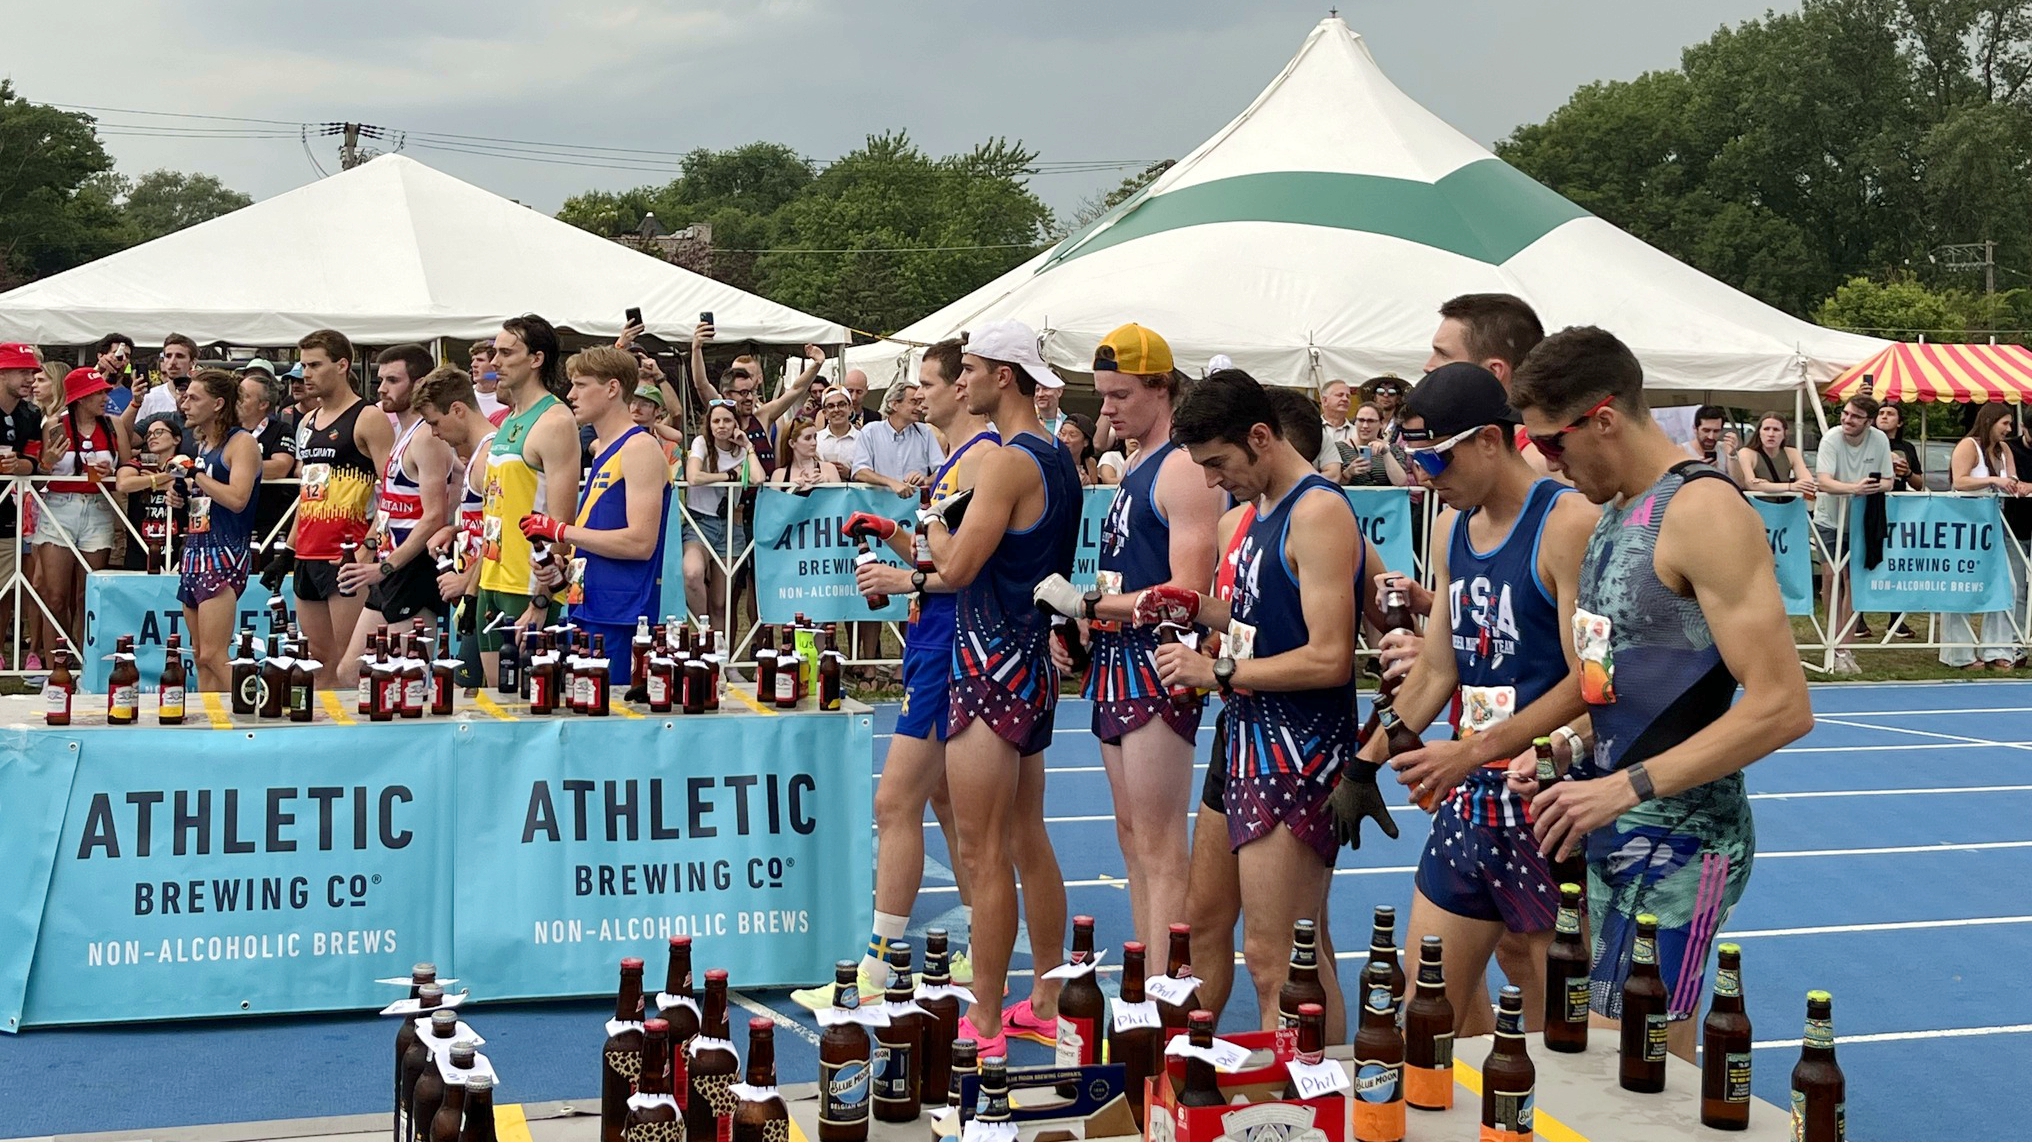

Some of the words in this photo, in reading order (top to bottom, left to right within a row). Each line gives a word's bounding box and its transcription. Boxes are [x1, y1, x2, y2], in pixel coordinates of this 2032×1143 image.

[300, 448, 336, 459] BELGIUM
[306, 484, 319, 498] 12
[1886, 522, 1992, 551] THLETIC
[1888, 558, 1950, 573] BREWING
[1871, 580, 1947, 592] NON-ALCOHOLIC
[1950, 581, 1984, 593] BREWS
[1449, 576, 1520, 641] USA
[1493, 639, 1515, 655] TEAM
[521, 773, 817, 844] ATHLETIC
[76, 784, 414, 860] ATHLETIC
[575, 859, 731, 897] BREWING
[134, 875, 309, 916] BREWING
[534, 913, 727, 945] NON-ALCOHOLIC
[738, 910, 809, 936] BREWS
[88, 933, 300, 967] NON-ALCOHOLIC
[313, 929, 397, 957] BREWS
[1149, 982, 1178, 1000] Phil
[1117, 1013, 1150, 1027] Phil
[1275, 1030, 1295, 1038] Drink
[830, 1080, 853, 1094] BLUE
[1300, 1071, 1337, 1094] Phil
[1355, 1079, 1375, 1091] BLUE
[1375, 1071, 1398, 1084] MOON
[830, 1101, 857, 1111] BELGIAN
[1177, 1107, 1186, 1120] 6
